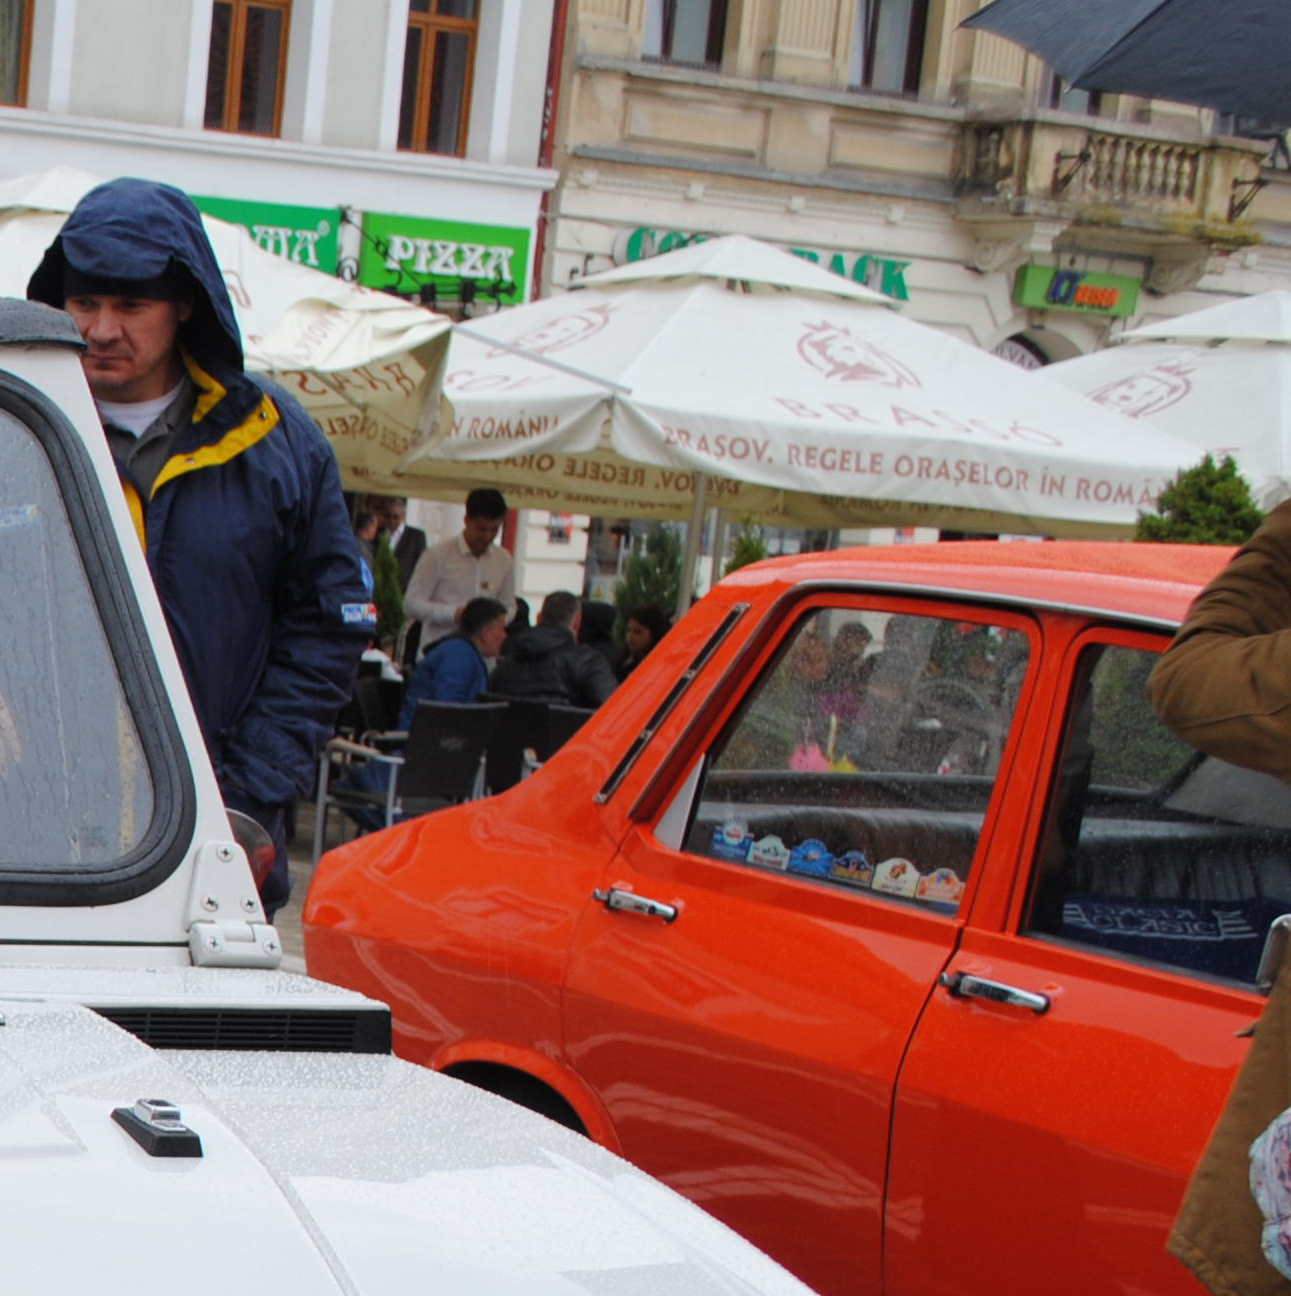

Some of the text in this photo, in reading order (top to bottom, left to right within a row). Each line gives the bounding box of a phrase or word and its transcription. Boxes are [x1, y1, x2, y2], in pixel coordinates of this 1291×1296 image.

[385, 234, 515, 282] PIZZA
[785, 443, 885, 476] REGELE
[893, 454, 1030, 492] ORAȘELOR
